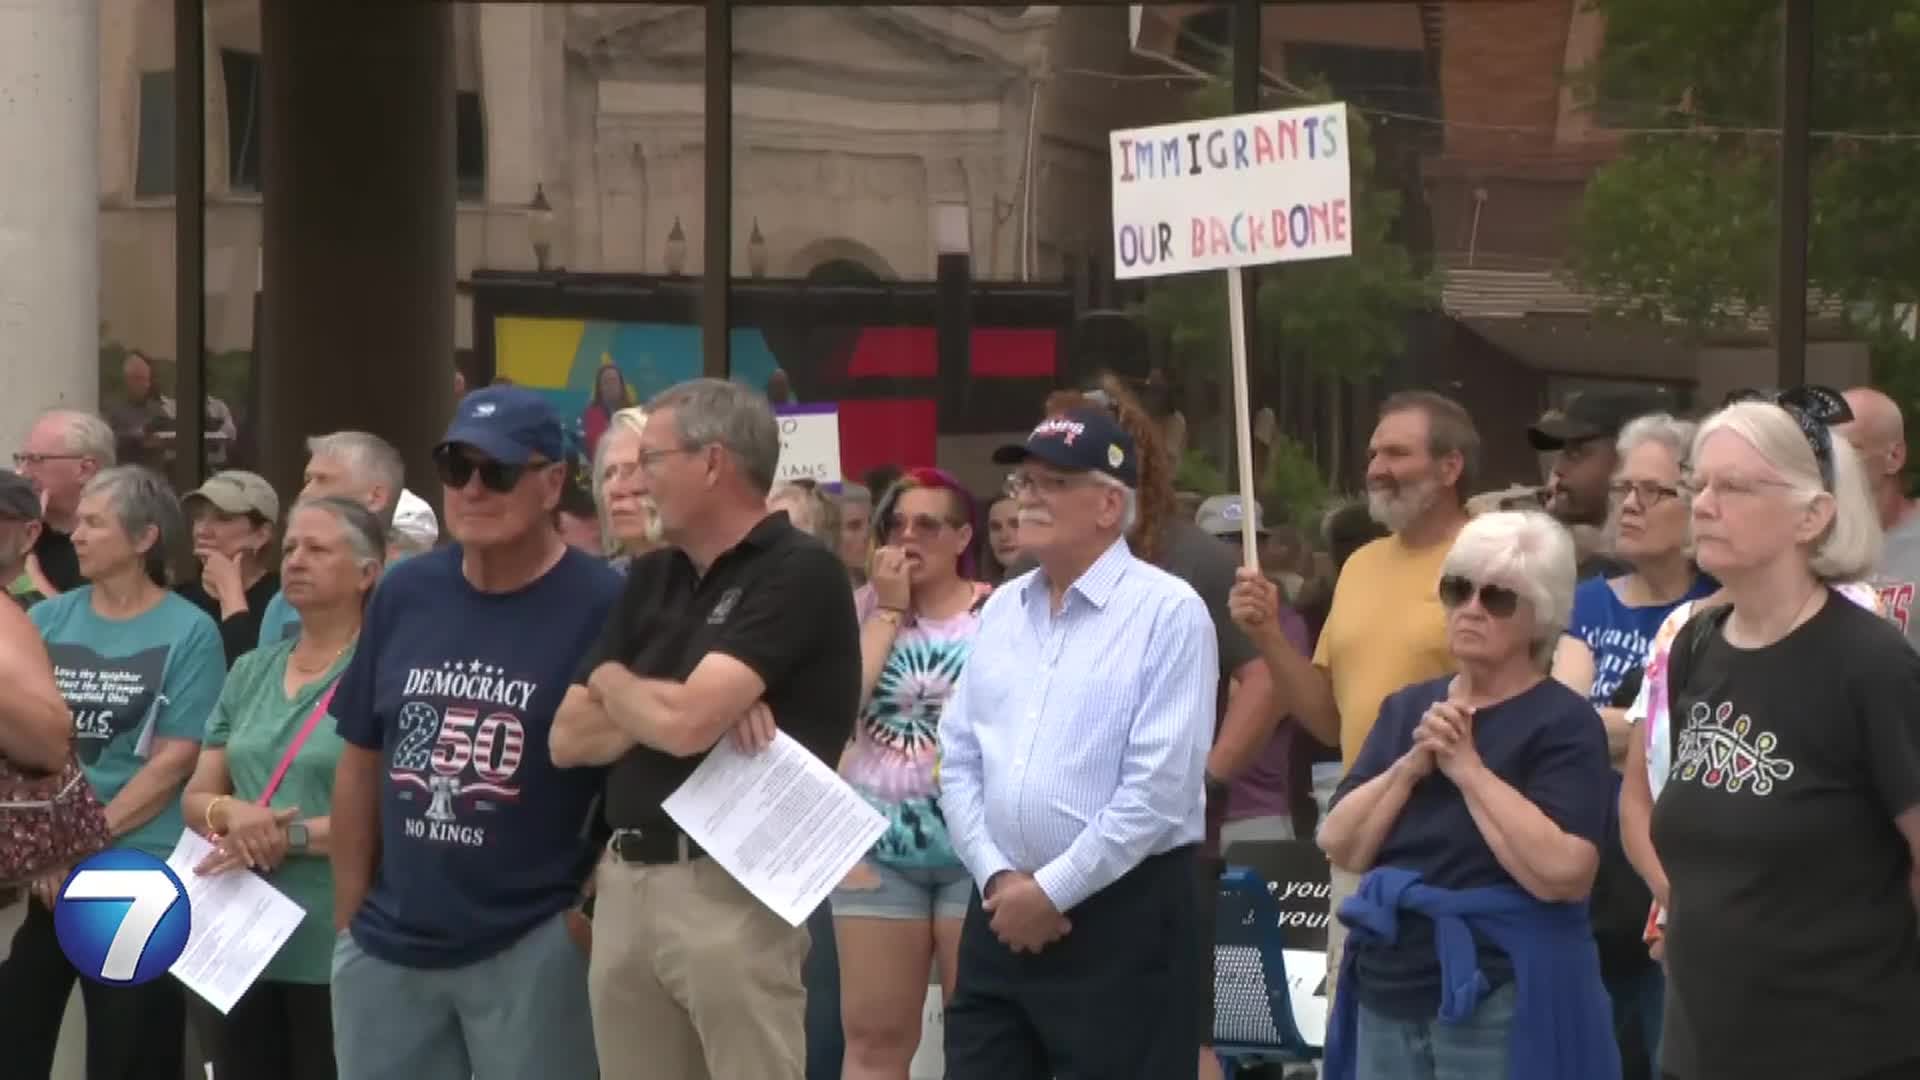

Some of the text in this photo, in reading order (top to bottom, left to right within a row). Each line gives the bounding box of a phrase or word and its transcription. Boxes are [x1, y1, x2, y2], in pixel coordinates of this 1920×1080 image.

[1119, 115, 1338, 182] IMMIGRANTS
[1119, 199, 1346, 267] OUR BACKBONE
[402, 667, 537, 711] DEMOCRACY
[392, 701, 525, 784] 250
[405, 818, 484, 846] NO KINGS
[1279, 881, 1332, 900] you
